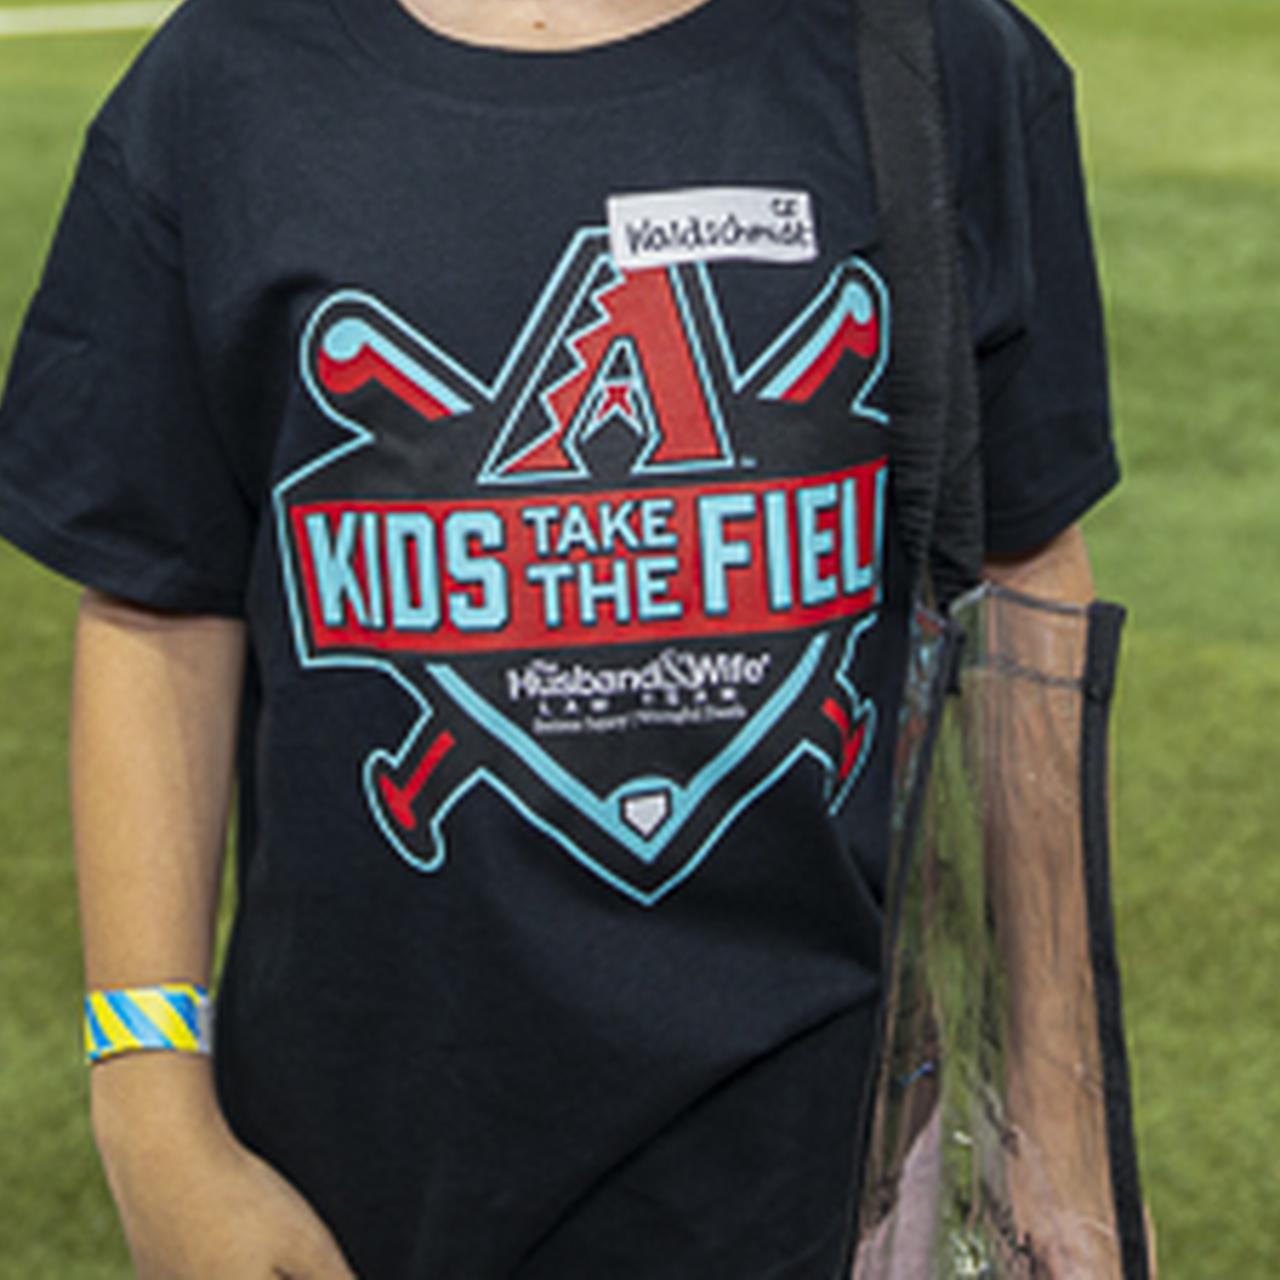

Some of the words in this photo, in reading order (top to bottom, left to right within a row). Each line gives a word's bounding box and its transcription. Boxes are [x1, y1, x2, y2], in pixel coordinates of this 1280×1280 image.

[305, 508, 508, 630] KIDS
[522, 498, 678, 555] TAKE
[696, 465, 888, 615] FIEL
[526, 556, 682, 627] THE
